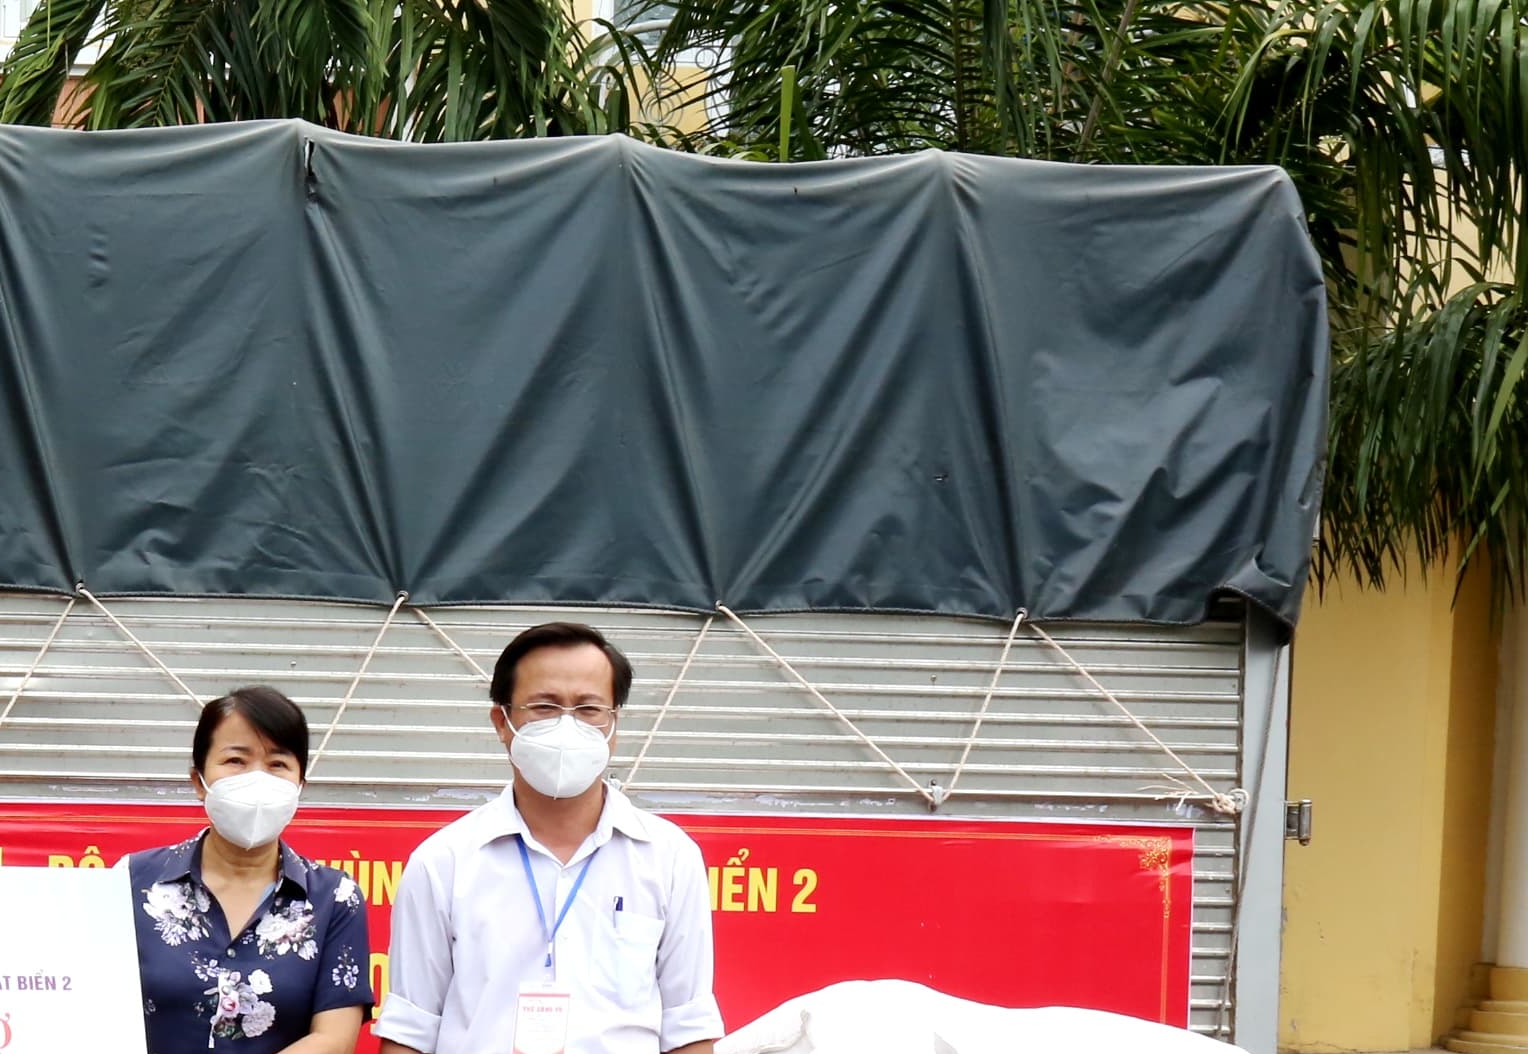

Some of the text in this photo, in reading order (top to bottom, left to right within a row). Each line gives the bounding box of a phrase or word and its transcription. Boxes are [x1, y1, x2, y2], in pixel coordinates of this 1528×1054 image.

[708, 848, 778, 912] IỂN
[792, 868, 818, 912] 2
[17, 969, 57, 991] BIỂN
[62, 976, 72, 991] 2
